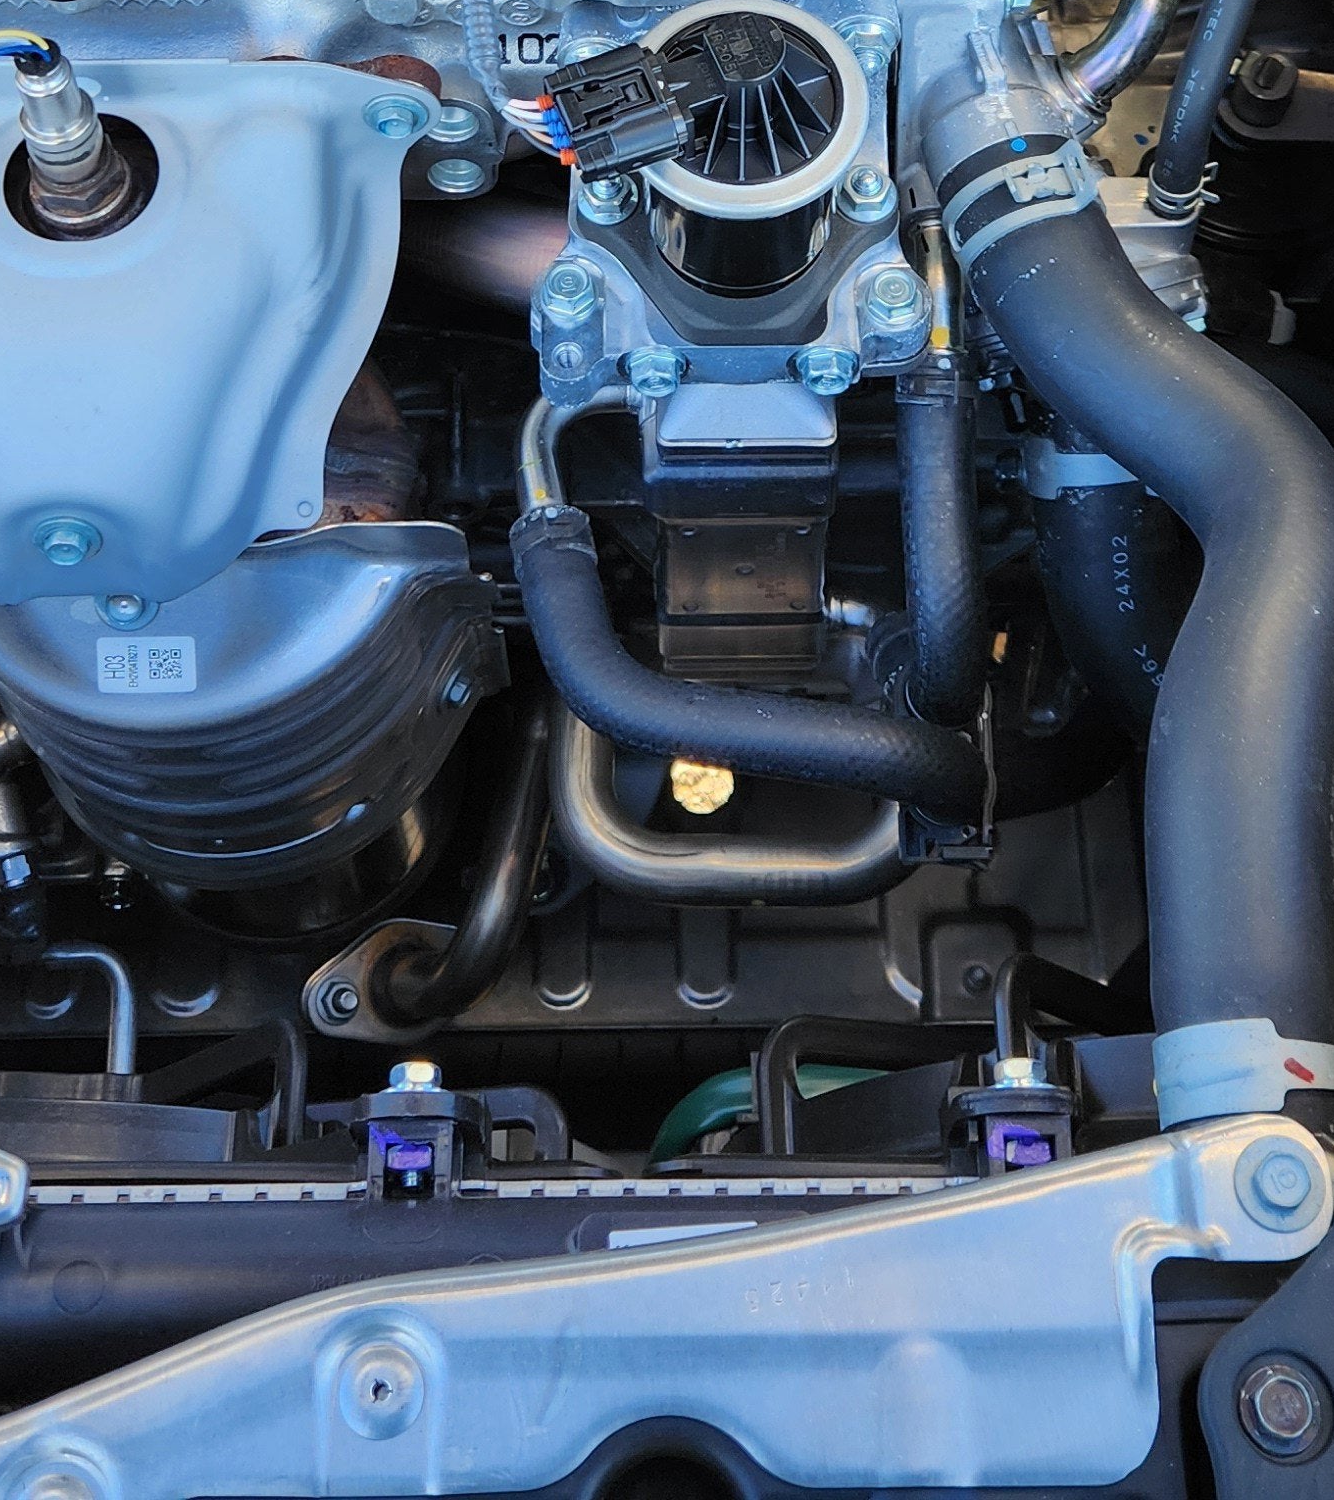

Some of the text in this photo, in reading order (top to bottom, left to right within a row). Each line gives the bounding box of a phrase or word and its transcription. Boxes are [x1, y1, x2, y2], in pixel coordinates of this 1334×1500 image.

[498, 33, 561, 65] 102
[1170, 67, 1200, 145] >EPDM<
[1112, 535, 1135, 613] 24X02
[104, 655, 125, 679] H03
